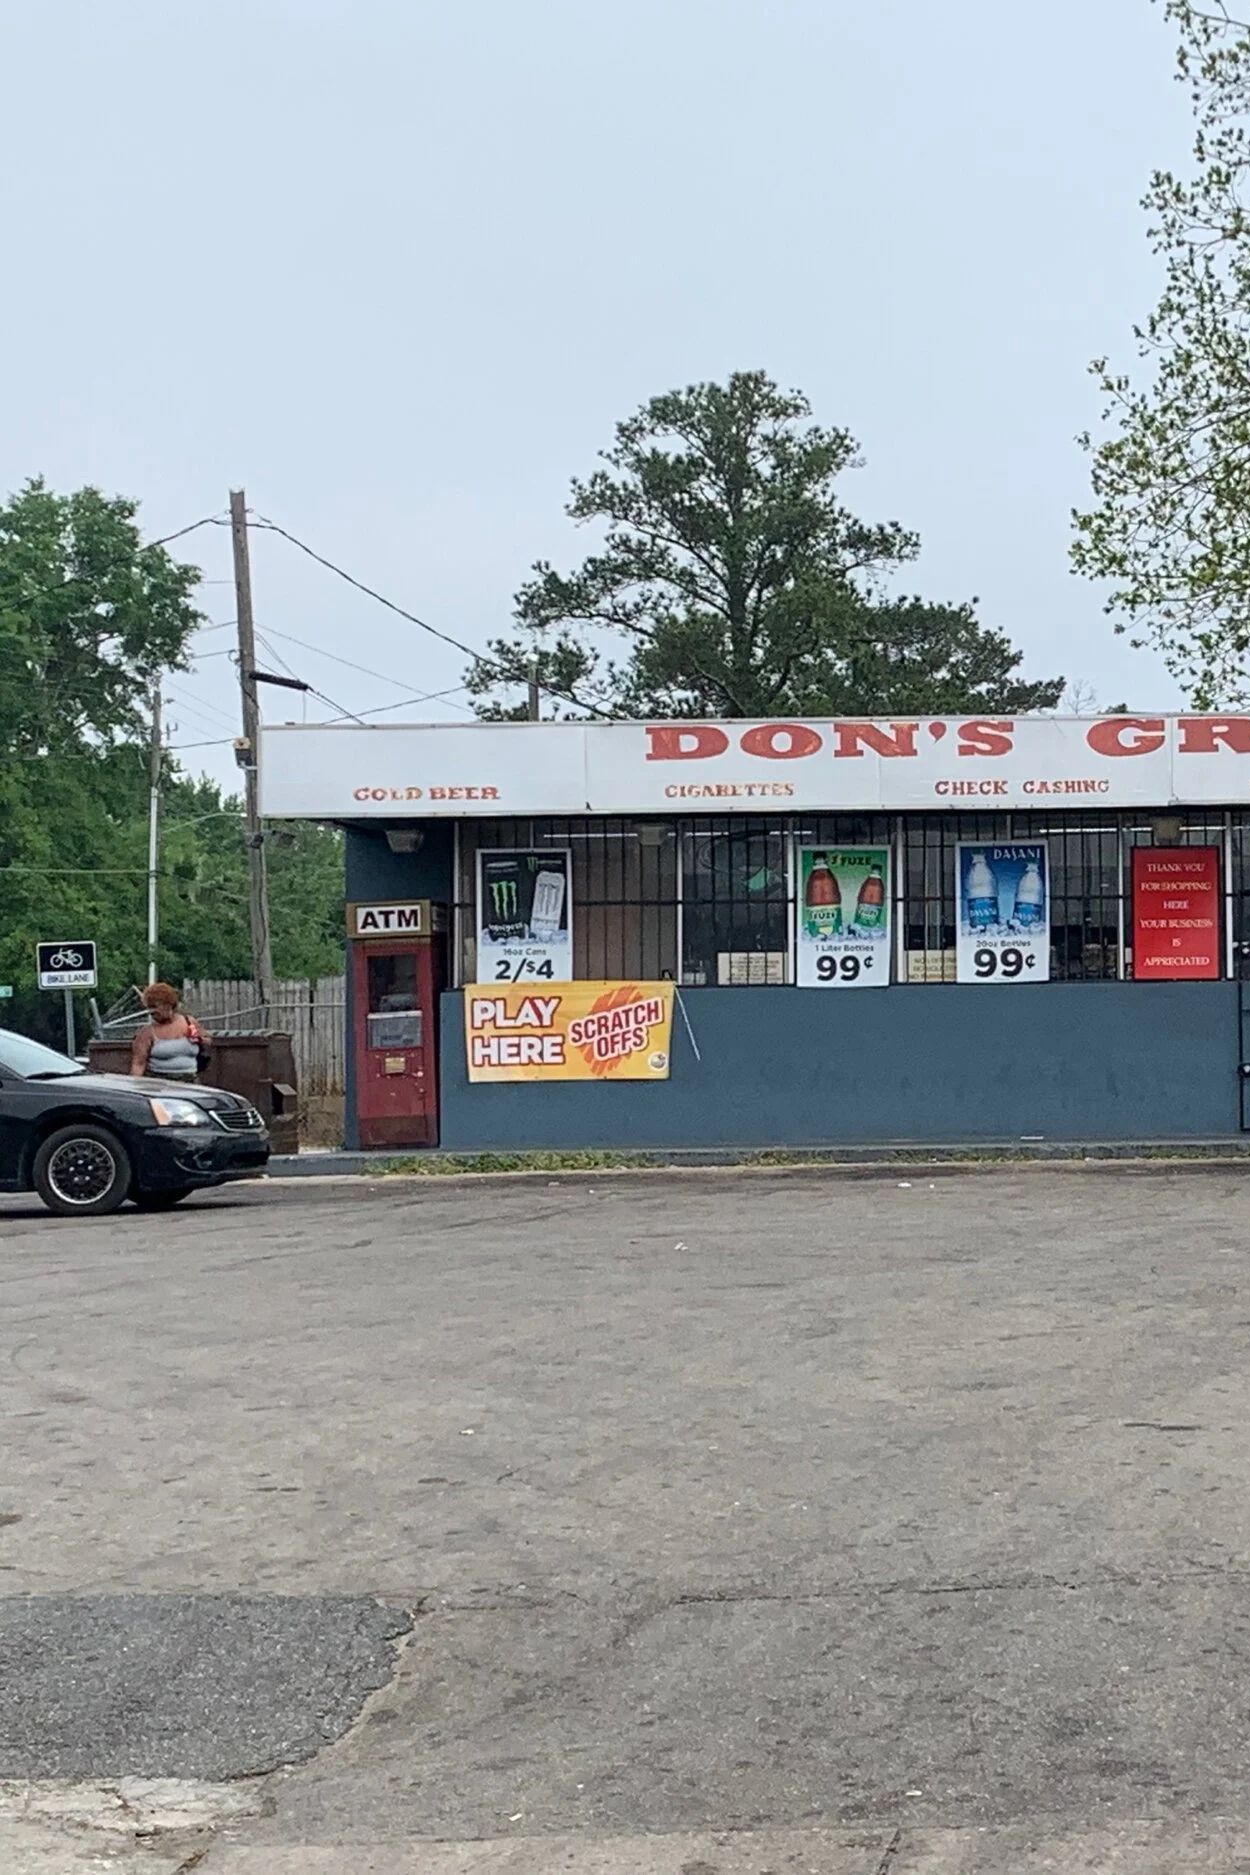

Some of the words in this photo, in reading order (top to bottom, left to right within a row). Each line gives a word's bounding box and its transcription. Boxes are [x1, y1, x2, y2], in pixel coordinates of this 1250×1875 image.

[645, 720, 1014, 761] DON'S
[354, 787, 422, 801] COLD
[428, 787, 500, 800] BEER
[664, 783, 794, 798] CIGARETTES
[935, 780, 1009, 795] CHECK
[1022, 780, 1109, 794] CASHING
[993, 848, 1041, 861] DASANI
[1147, 863, 1181, 872] THANK
[1184, 863, 1205, 872] YOU
[1141, 882, 1160, 891] FOR
[1161, 882, 1212, 891] SHOPPING
[1163, 900, 1189, 909] HERE
[360, 909, 418, 930] ATM
[1140, 919, 1167, 928] YOUR
[1168, 919, 1213, 928] BUSINESS
[1172, 938, 1181, 947] IS
[1144, 956, 1210, 966] APPRECIATED
[495, 958, 554, 983] 2/$4
[68, 973, 89, 983] LANE
[471, 996, 561, 1029] PLAY
[570, 999, 661, 1043] SCRATCH
[596, 1026, 645, 1059] OFFS
[472, 1035, 565, 1067] HERE
